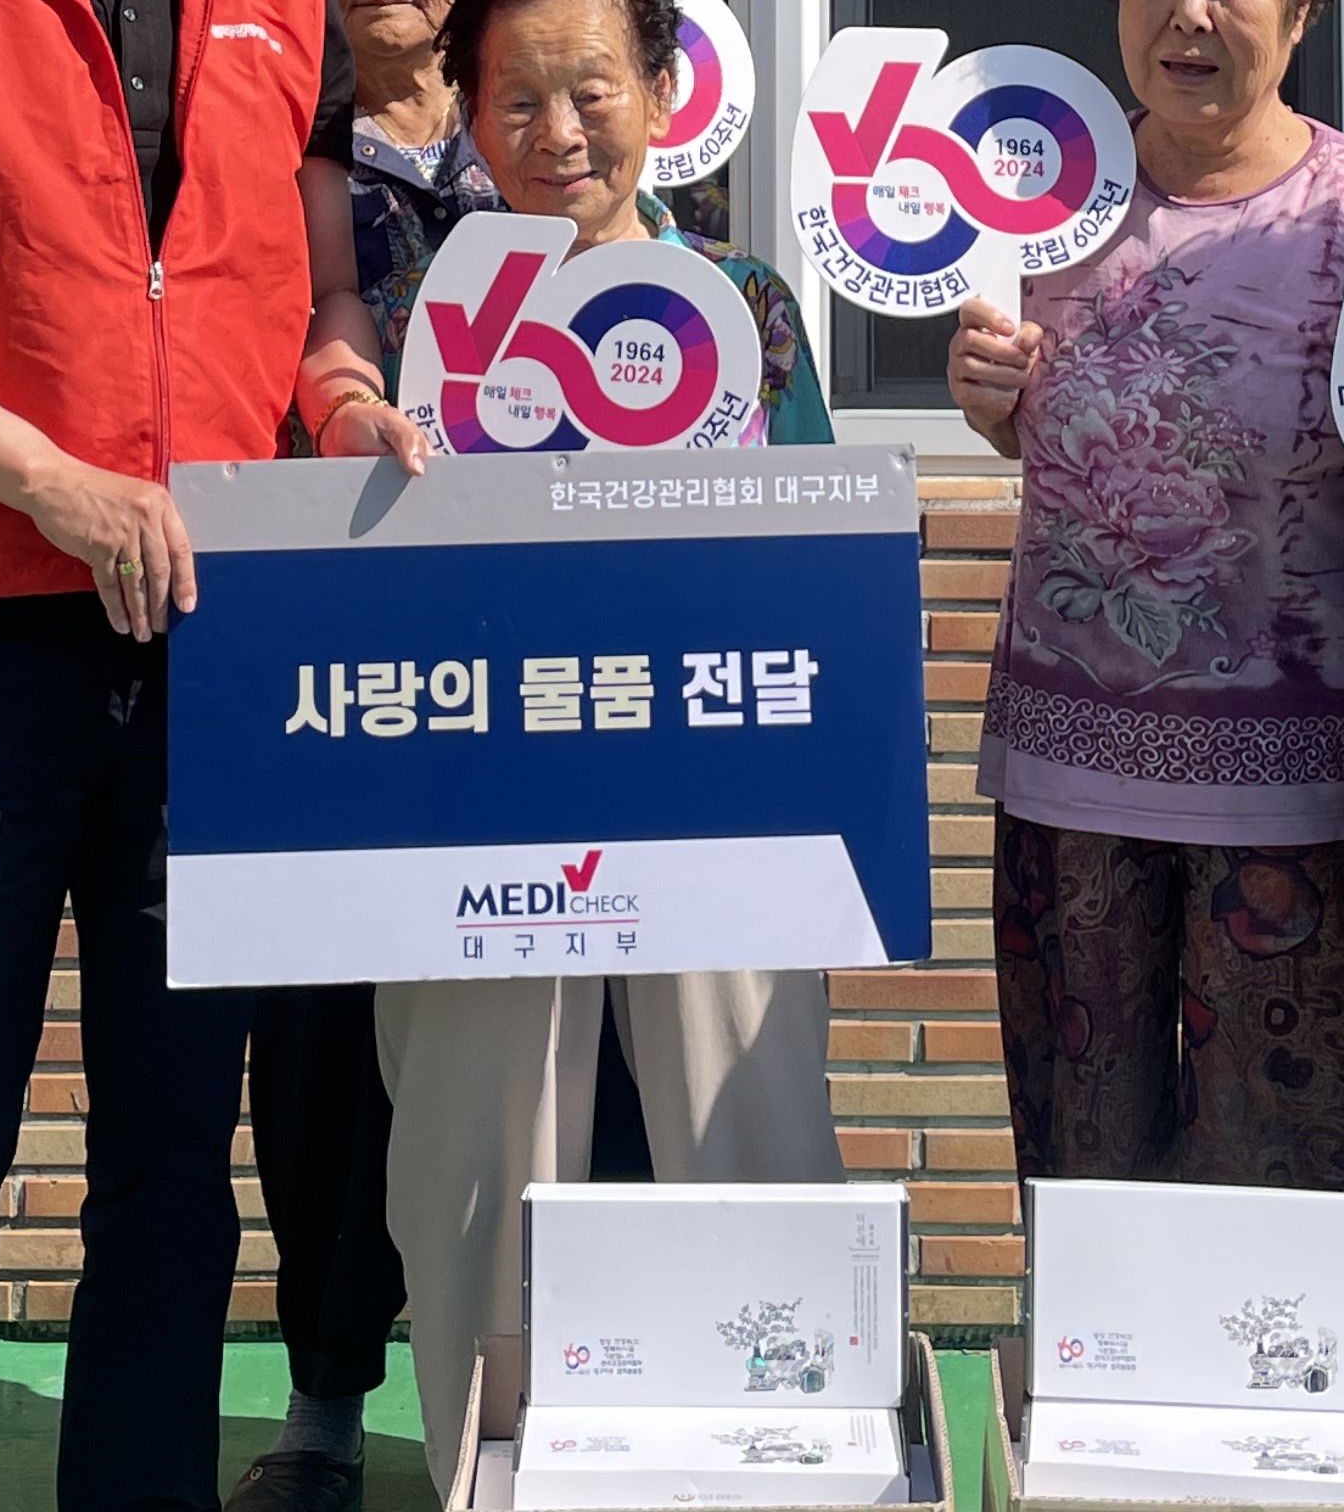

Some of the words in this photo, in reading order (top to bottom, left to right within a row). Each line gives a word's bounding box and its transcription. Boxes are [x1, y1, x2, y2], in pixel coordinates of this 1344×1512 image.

[655, 151, 696, 181] 창립
[699, 102, 748, 165] 60주년
[994, 138, 1044, 158] 1964
[994, 159, 1045, 178] 2024
[898, 201, 920, 215] 내일
[1019, 236, 1070, 270] 창립
[1073, 178, 1131, 248] 60주년
[798, 204, 970, 309] 한국건강관리협회
[613, 339, 666, 363] 1964
[610, 363, 664, 386] 2024
[484, 385, 507, 400] 매일
[508, 404, 531, 419] 내일
[686, 390, 750, 448] 0주년
[549, 476, 763, 511] 한국건강관리협회
[775, 474, 881, 506] 대구지부
[285, 657, 490, 739] 사랑의
[518, 653, 655, 734] 물품
[682, 648, 819, 728] 전달
